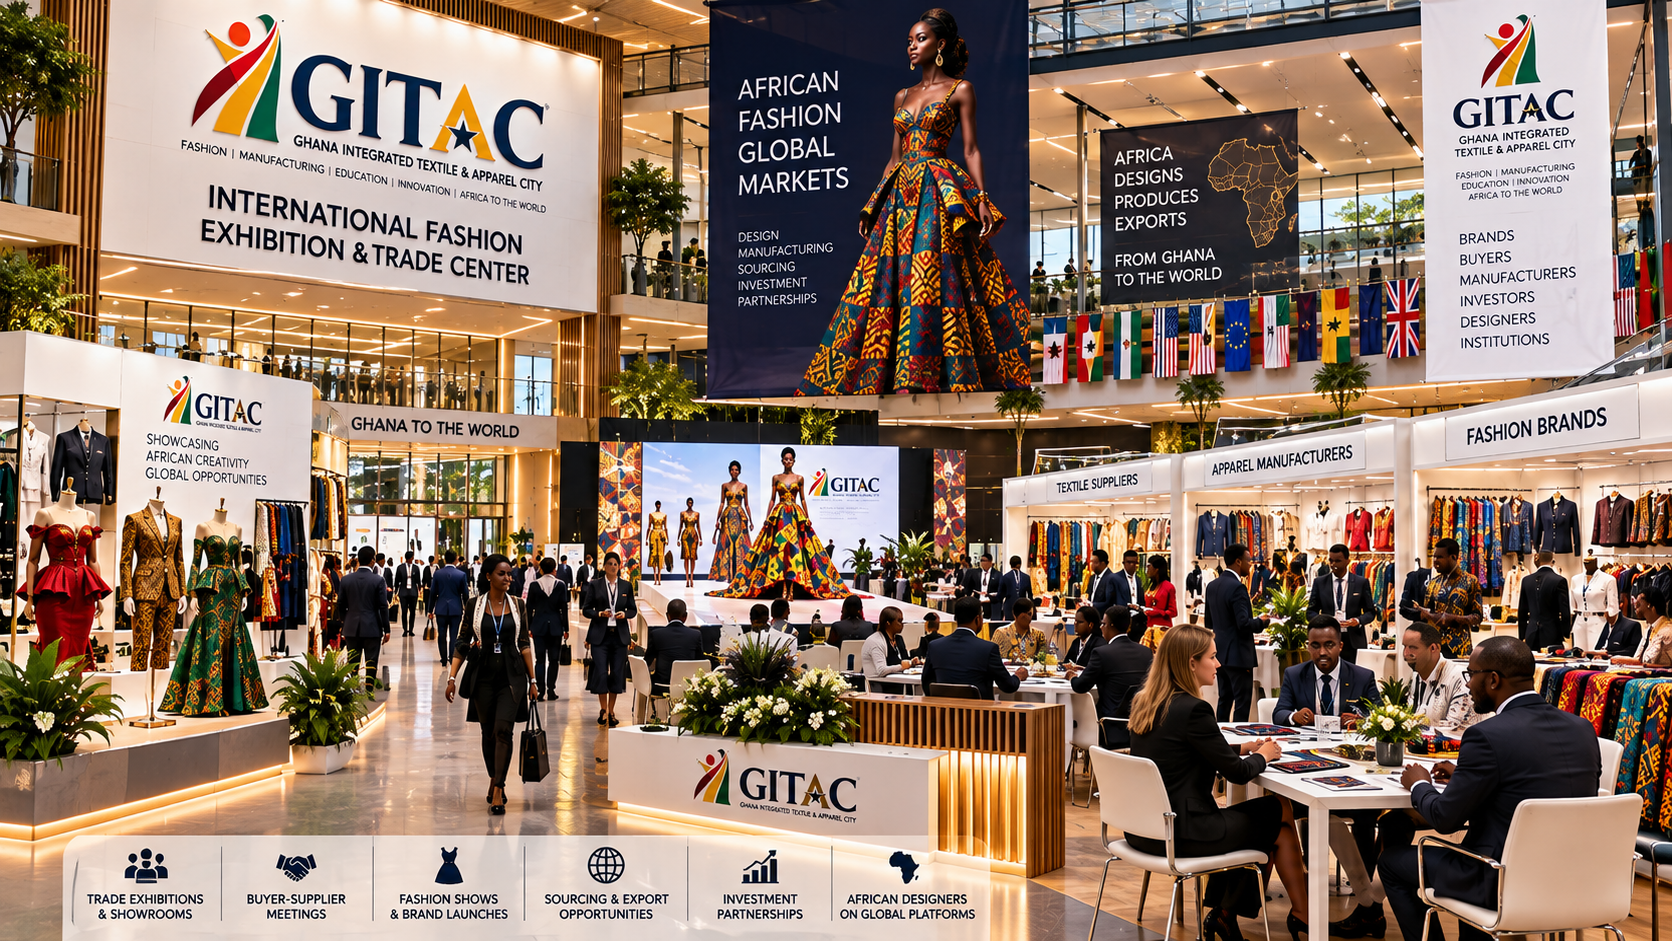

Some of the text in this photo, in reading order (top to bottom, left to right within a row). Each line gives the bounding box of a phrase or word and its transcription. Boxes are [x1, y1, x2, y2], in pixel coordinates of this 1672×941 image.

[738, 71, 838, 100] AFRICAN
[291, 54, 545, 170] GITAC
[740, 102, 840, 131] FASHION
[1453, 89, 1575, 129] GITAC
[1459, 127, 1569, 144] GHANA INTEGRATED
[739, 136, 835, 163] GLOBAL
[1114, 146, 1173, 166] AFRICA
[1455, 139, 1576, 157] TEXTILE & APPAREL CITY
[294, 135, 543, 192] GHANA INTEGRATED TEXTILE & APPAREL CITY
[1456, 170, 1492, 180] FASHION
[1501, 163, 1575, 175] MANUFACTURING
[181, 140, 227, 156] FASHION
[240, 150, 325, 174] MANUFACTURING
[335, 168, 387, 185] EDUCATION
[398, 179, 450, 196] INNOVATION
[460, 191, 488, 203] AFRICA
[490, 195, 501, 205] TO
[503, 198, 517, 208] THE
[519, 201, 546, 213] WORLD
[739, 167, 848, 195] MARKETS
[1115, 167, 1183, 187] DESIGNS
[1462, 180, 1509, 190] EDUCATION
[1517, 175, 1569, 185] INNOVATION
[1115, 189, 1198, 209] PRODUCES
[1469, 186, 1562, 200] AFRICA TO THE WORLD
[209, 184, 522, 255] INTERNATIONAL FASHION
[1116, 212, 1186, 231] EXPORTS
[739, 230, 779, 242] DESIGN
[1460, 230, 1514, 245] BRANDS
[201, 218, 529, 285] EXHIBITION & TRADE CENTER
[738, 242, 833, 258] MANUFACTURING
[1116, 248, 1215, 267] FROM GHANA
[1460, 251, 1511, 266] BUYERS
[738, 261, 795, 274] SOURCING
[1115, 267, 1222, 286] TO THE WORLD
[1460, 266, 1576, 286] MANUFACTURERS
[738, 277, 807, 290] INVESTMENT
[738, 293, 817, 306] PARTNERSHIPS
[1461, 291, 1535, 307] INVESTORS
[1461, 312, 1536, 328] DESIGNERS
[1461, 333, 1549, 348] INSTITUTIONS
[194, 393, 262, 426] GITAC
[352, 417, 519, 438] GHANA TO THE WORLD
[1467, 407, 1607, 445] FASHION BRANDS
[147, 433, 219, 451] SHOWCASING
[146, 450, 249, 469] AFRICAN CREATIVITY
[1212, 445, 1352, 476] APPAREL MANUFACTURERS
[146, 467, 267, 486] GLOBAL OPPORTUNITIES
[830, 477, 880, 492] GITAC
[1057, 473, 1138, 493] TEXTILE SUPPLIERS
[739, 767, 857, 813] GITAC
